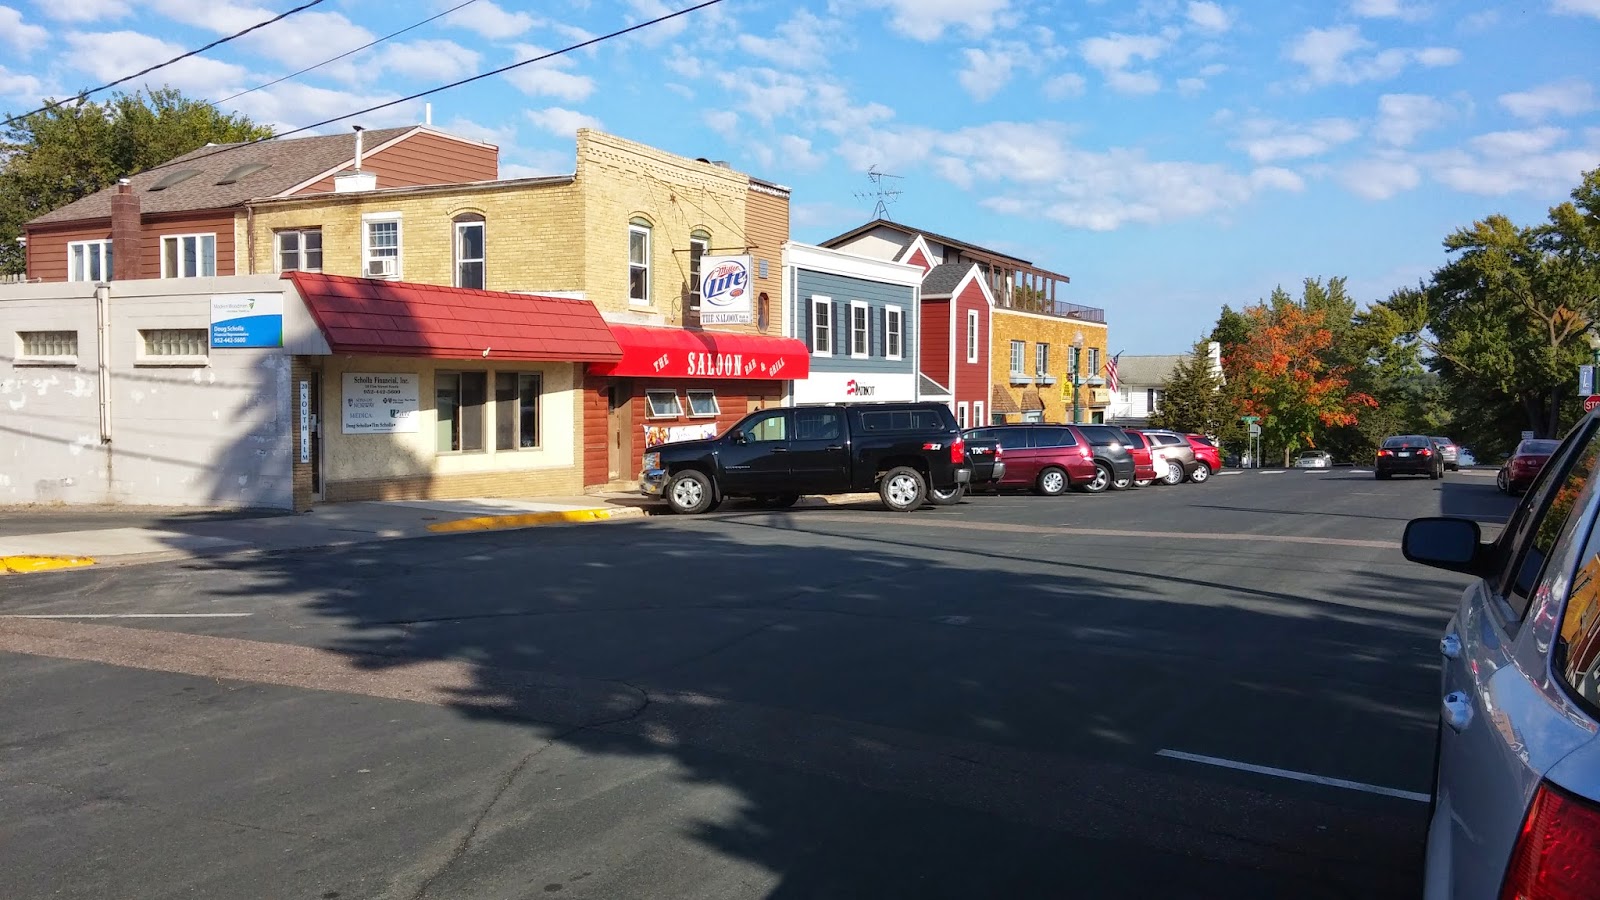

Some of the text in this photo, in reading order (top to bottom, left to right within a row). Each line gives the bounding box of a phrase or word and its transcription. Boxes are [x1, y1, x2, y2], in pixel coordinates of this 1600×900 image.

[714, 265, 741, 277] Miller
[707, 271, 746, 298] Lite
[702, 313, 739, 323] THE SALOON
[653, 351, 785, 377] THE SALOON BAR & GRILL
[400, 377, 409, 385] Inc.
